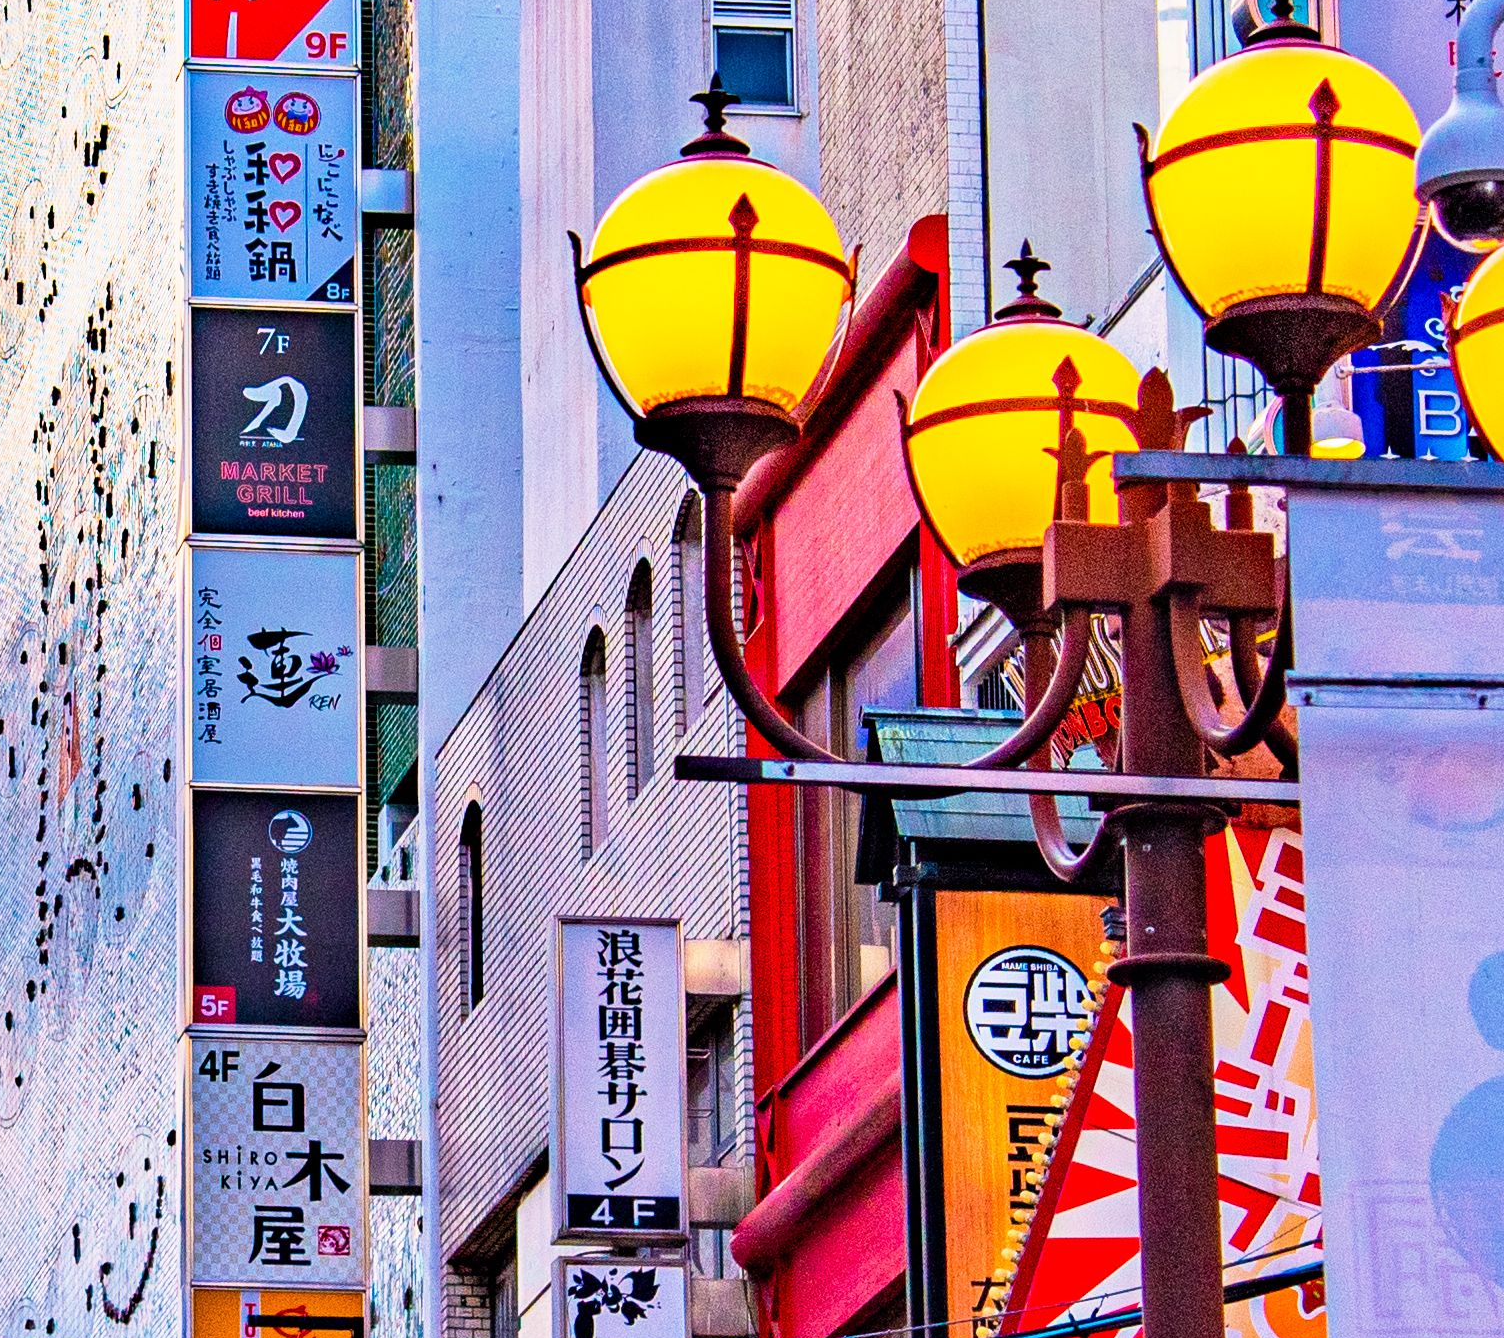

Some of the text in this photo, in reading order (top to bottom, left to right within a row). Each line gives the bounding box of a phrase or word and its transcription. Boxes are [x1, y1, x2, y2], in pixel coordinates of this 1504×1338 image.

[305, 32, 347, 59] 9F
[326, 283, 350, 300] 8F
[257, 327, 290, 355] 7F
[220, 461, 328, 484] MARKET
[236, 483, 314, 506] GRILL
[247, 508, 305, 519] beef kitchen
[308, 693, 342, 712] REN
[249, 857, 264, 963] 黒毛和牛食べ放題
[274, 856, 309, 1000] 焼肉屋大牧場
[200, 995, 230, 1017] 5F
[199, 1050, 241, 1083] 4F
[597, 928, 648, 1192] 浪花囲碁サロン
[1013, 1054, 1049, 1066] CAFE
[248, 1061, 352, 1267] 白木屋
